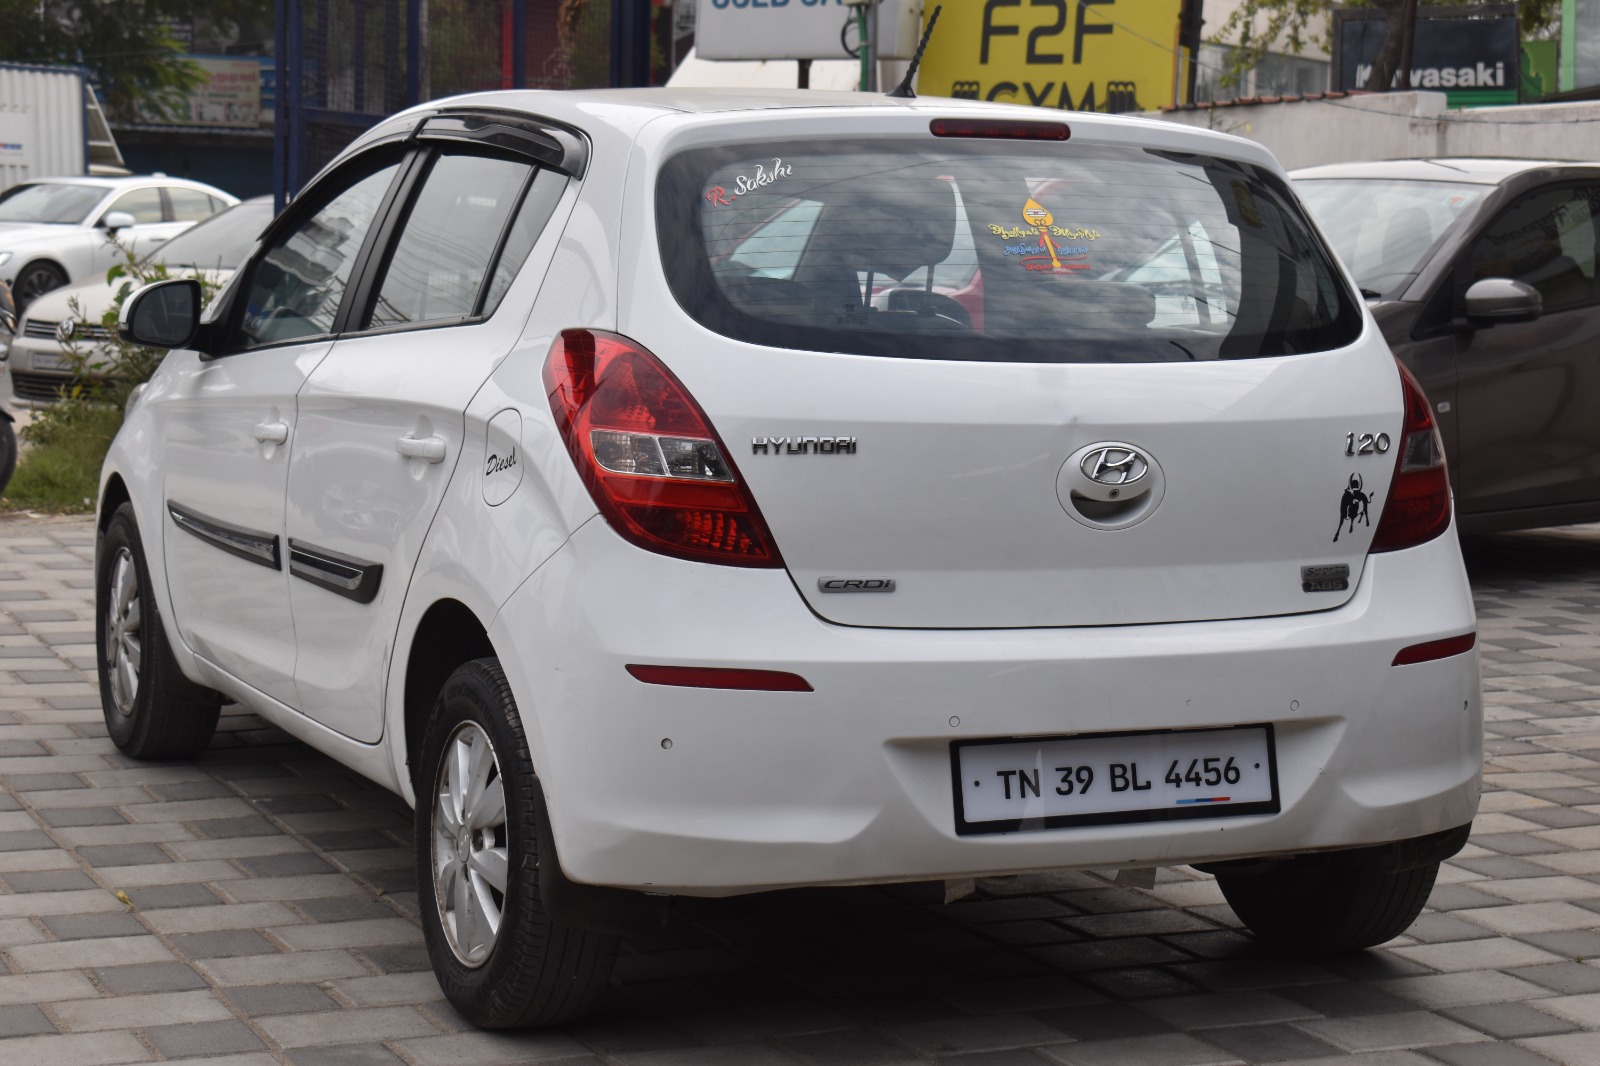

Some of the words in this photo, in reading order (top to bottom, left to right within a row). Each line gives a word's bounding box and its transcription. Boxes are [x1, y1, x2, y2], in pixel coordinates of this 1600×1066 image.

[979, 0, 1116, 64] F2F
[1355, 62, 1504, 88] Kwasaki
[752, 436, 857, 454] HYUNDAI
[1345, 431, 1391, 456] i20
[486, 445, 517, 476] Diesel
[997, 768, 1041, 799] TN
[1055, 766, 1094, 796] 39
[1109, 763, 1151, 793] BL
[1164, 756, 1241, 788] 4456
